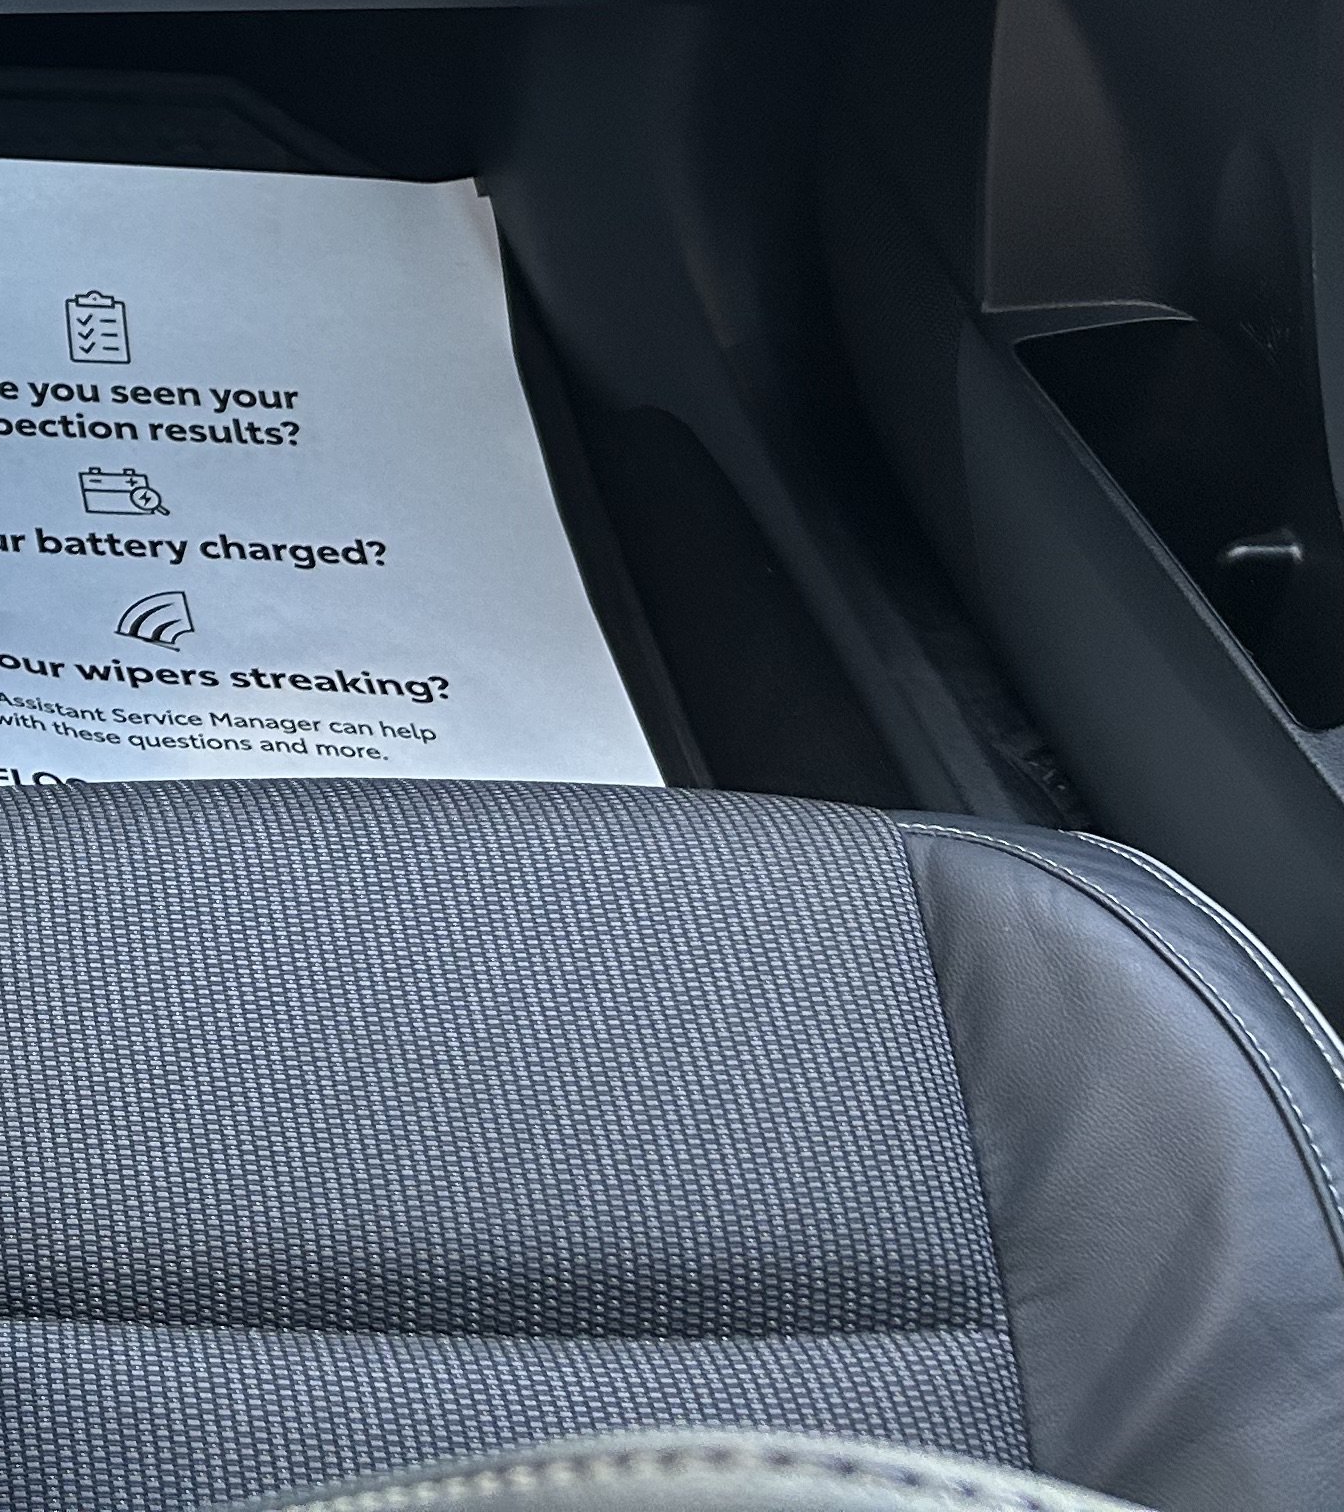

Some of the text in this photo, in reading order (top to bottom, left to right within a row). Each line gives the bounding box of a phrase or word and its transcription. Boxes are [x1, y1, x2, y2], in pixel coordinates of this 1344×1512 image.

[29, 380, 100, 406] you
[110, 383, 201, 405] seen
[210, 388, 299, 413] your
[148, 418, 300, 446] results?
[36, 528, 187, 564] battery
[199, 534, 387, 569] charged?
[75, 659, 220, 688] wipers
[230, 666, 450, 704] streaking?
[53, 719, 122, 745] these
[128, 729, 252, 755] questions
[259, 736, 309, 755] and
[315, 742, 390, 762] more.
[112, 708, 203, 728] Service
[209, 711, 320, 736] Manager
[328, 721, 372, 737] can
[379, 720, 437, 744] help
